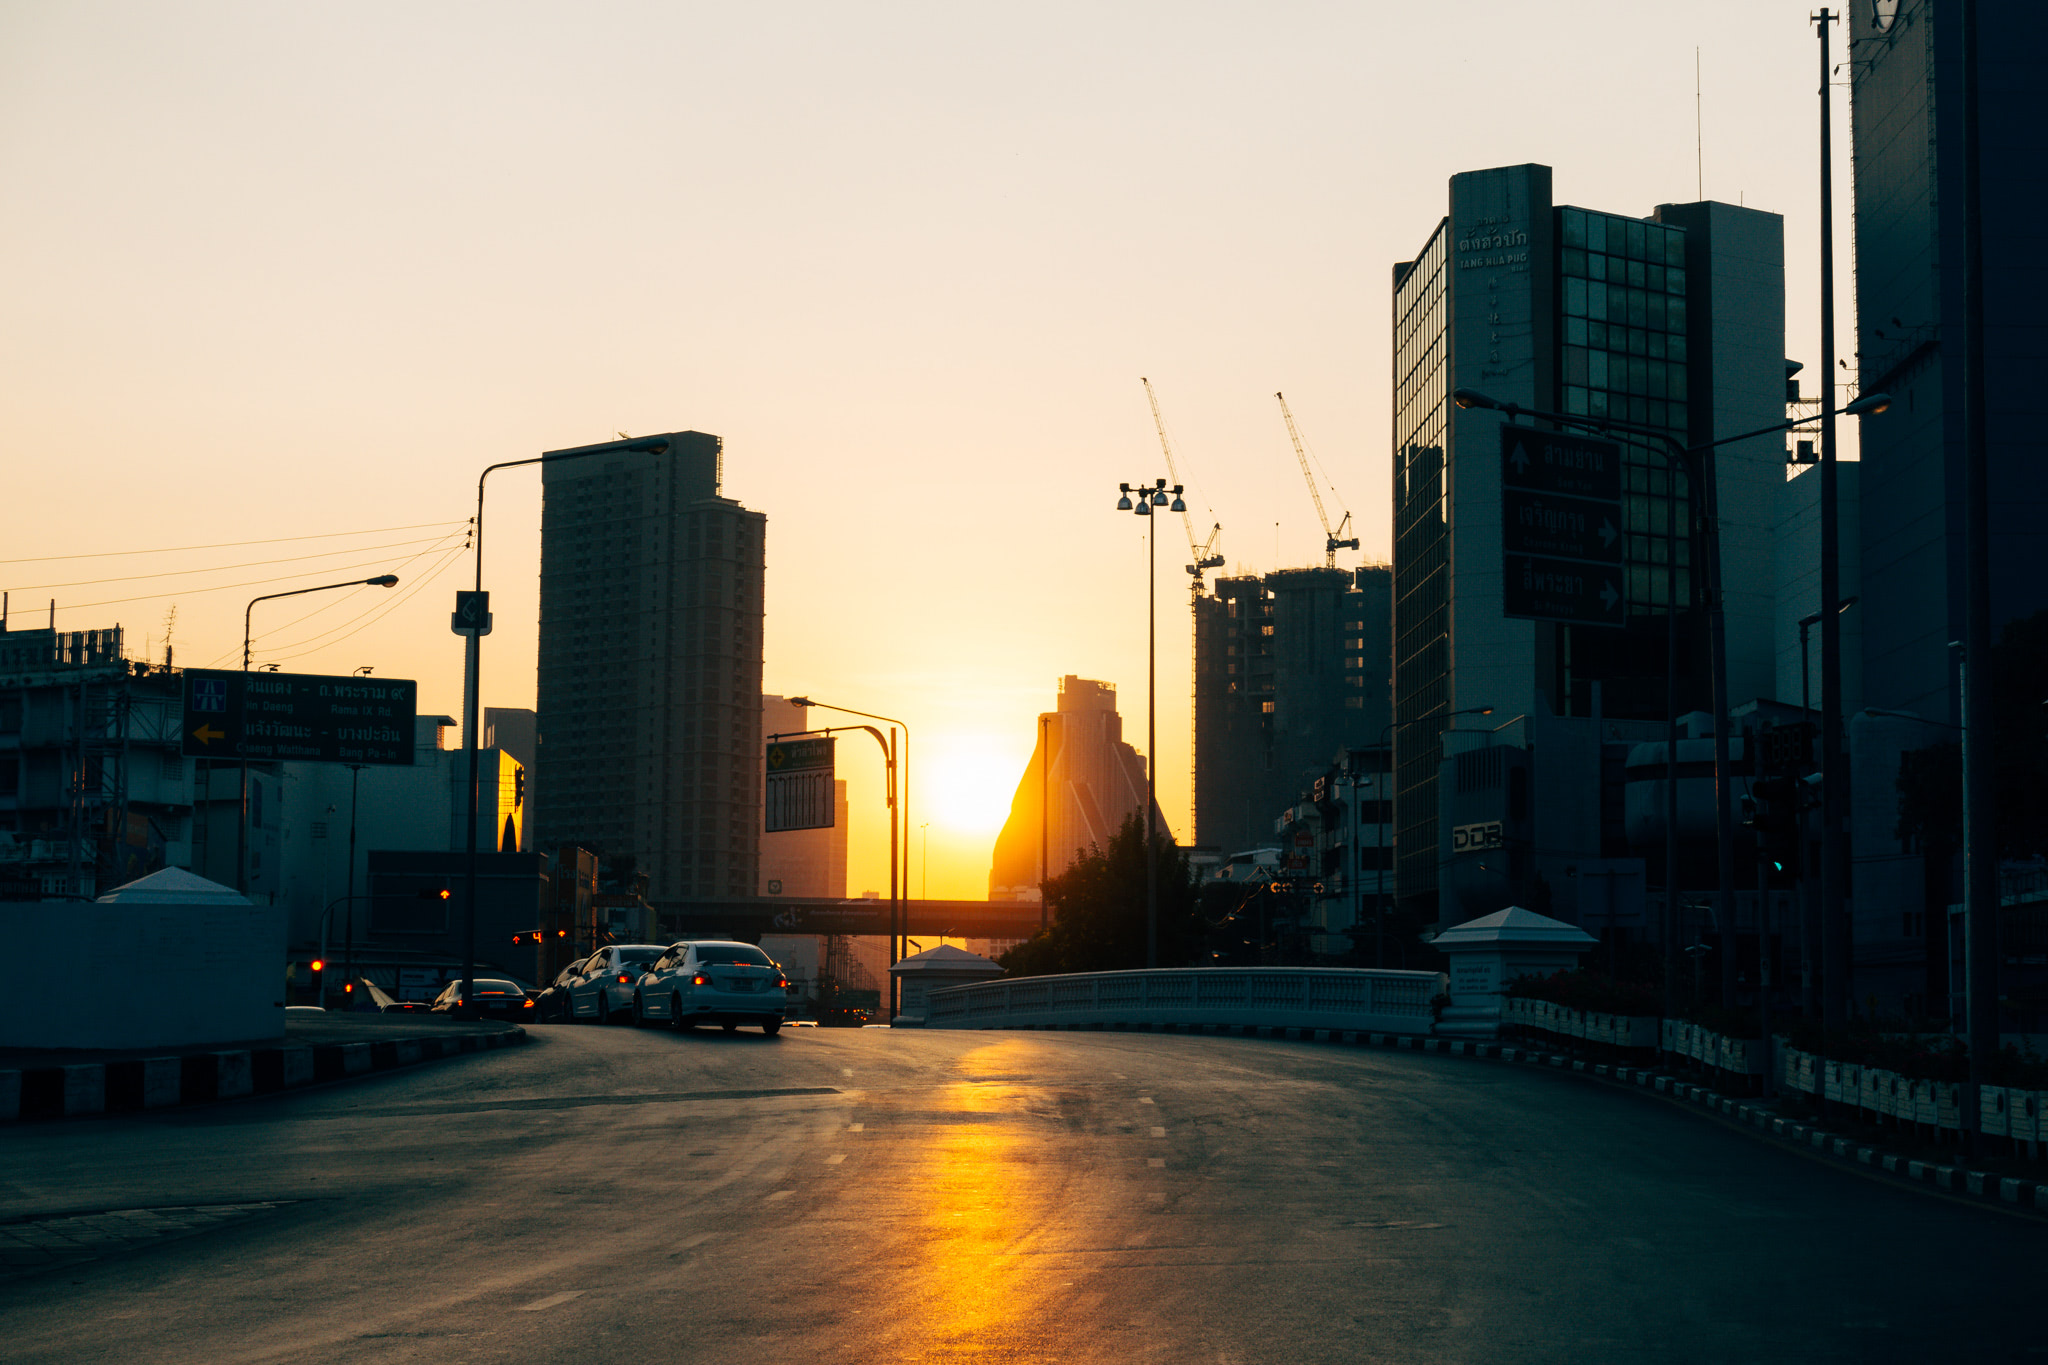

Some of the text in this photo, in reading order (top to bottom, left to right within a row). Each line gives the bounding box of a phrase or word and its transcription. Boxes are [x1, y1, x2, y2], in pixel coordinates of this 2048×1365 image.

[1507, 252, 1527, 264] PUG
[1519, 499, 1584, 539] เจริญกรุง
[263, 701, 294, 715] Daeng
[331, 704, 358, 716] Rama
[362, 705, 373, 716] IX
[337, 725, 401, 742] บางปะอิน
[277, 743, 321, 756] Watthana
[339, 746, 364, 761] Bang
[532, 932, 542, 944] 4
